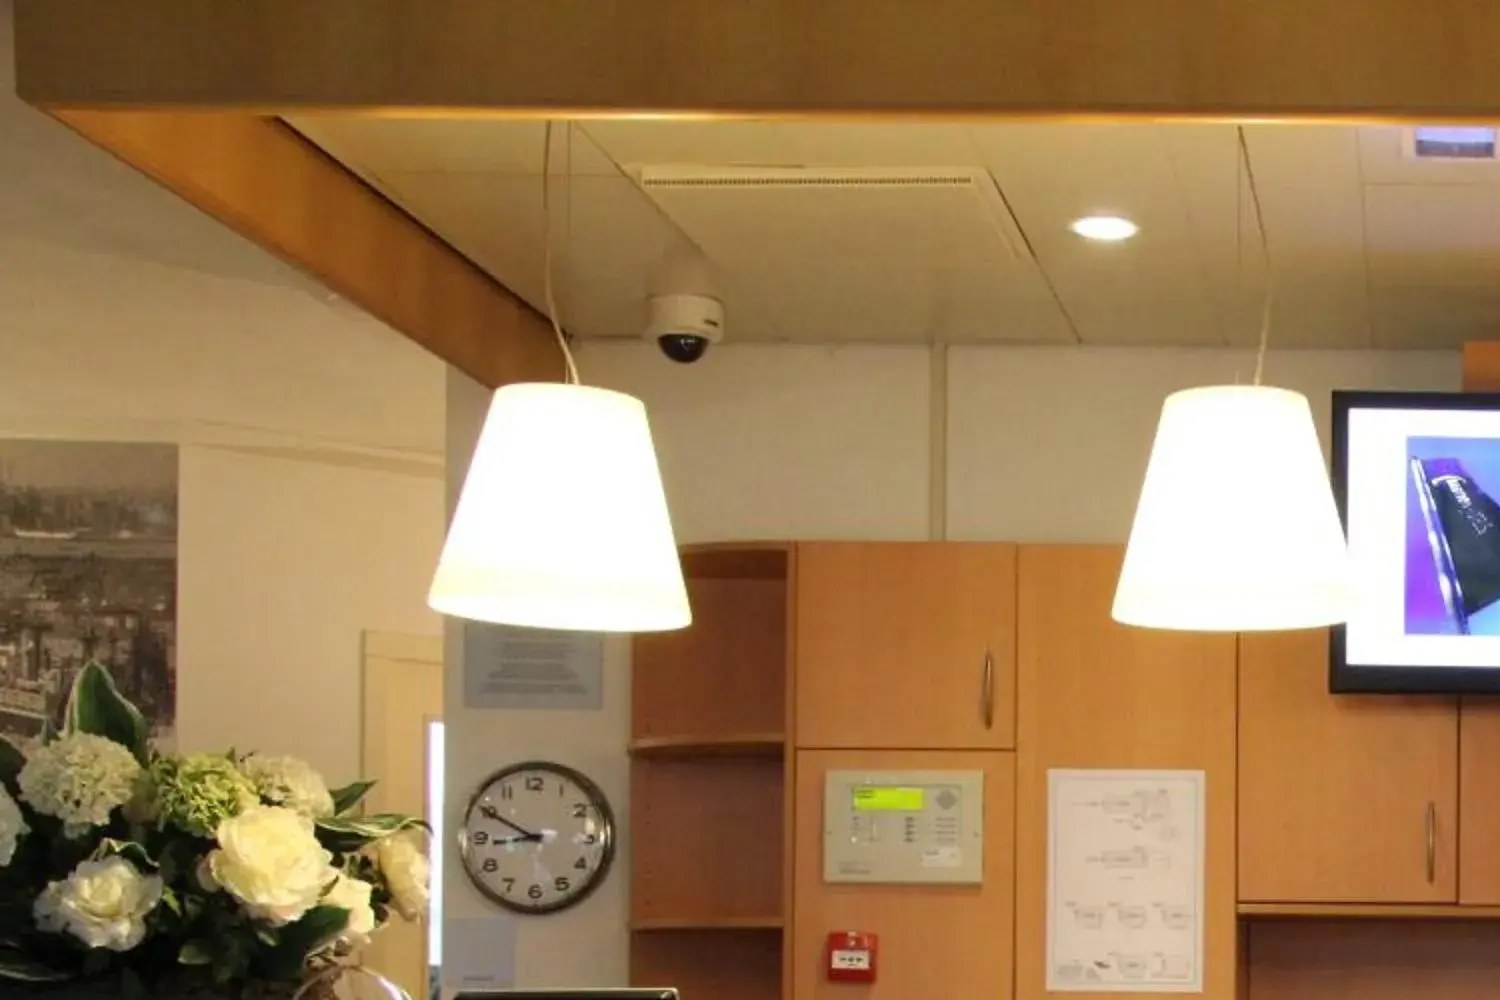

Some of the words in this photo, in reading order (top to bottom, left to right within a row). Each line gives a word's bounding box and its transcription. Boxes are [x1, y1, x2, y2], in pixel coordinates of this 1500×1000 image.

[525, 776, 545, 791] 12
[559, 783, 564, 797] 1
[502, 784, 513, 800] 11
[573, 803, 587, 818] 2
[474, 831, 489, 845] 9
[482, 857, 499, 873] 8
[573, 856, 587, 870] 4
[502, 877, 516, 893] 7
[527, 884, 543, 899] 6
[554, 876, 570, 892] 5
